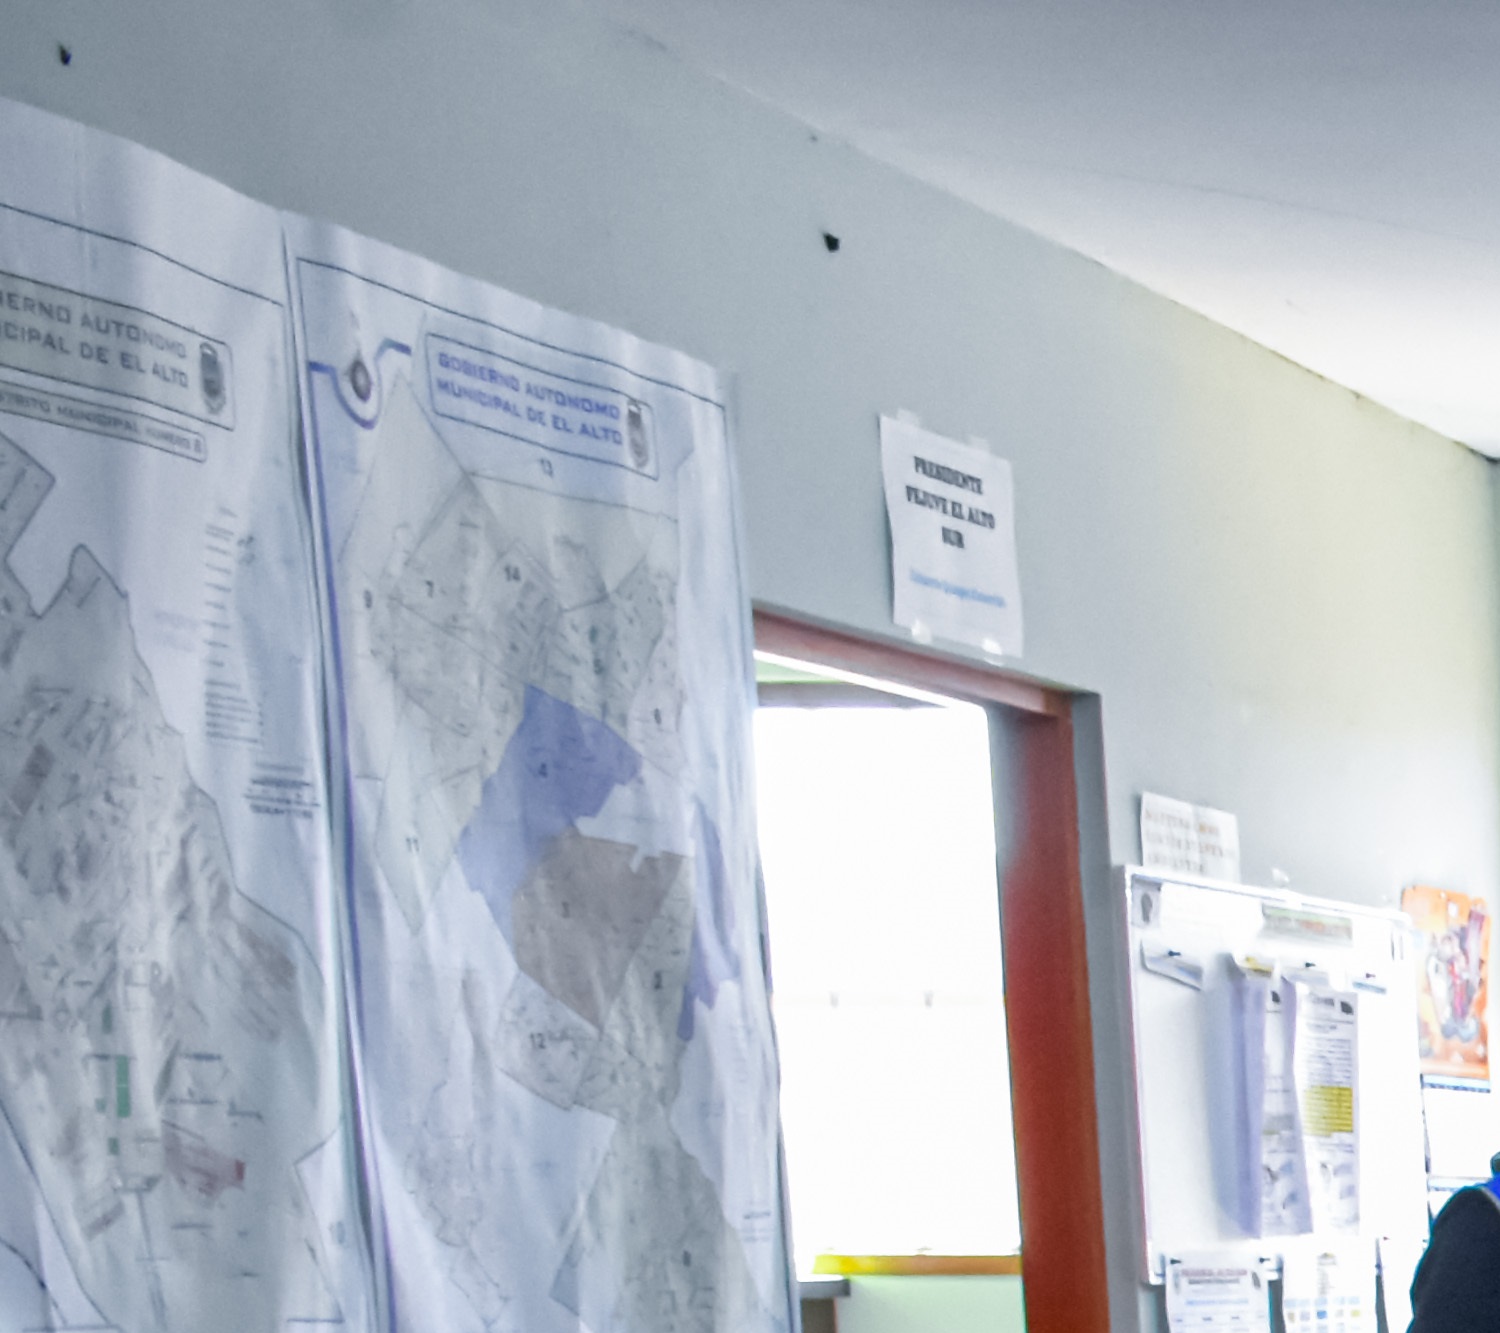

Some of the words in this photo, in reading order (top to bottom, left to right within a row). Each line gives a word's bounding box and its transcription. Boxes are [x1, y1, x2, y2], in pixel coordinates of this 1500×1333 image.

[80, 312, 188, 359] AUTONOMO
[80, 341, 109, 365] DE
[119, 351, 146, 375] EL
[152, 361, 189, 388] ALTO
[438, 352, 521, 391] GOBIERNO
[525, 382, 621, 421] AUTONOMO
[437, 378, 522, 418] MUNICIPAL
[526, 406, 547, 427] DE
[552, 414, 575, 434] EL
[579, 422, 623, 445] ALTO
